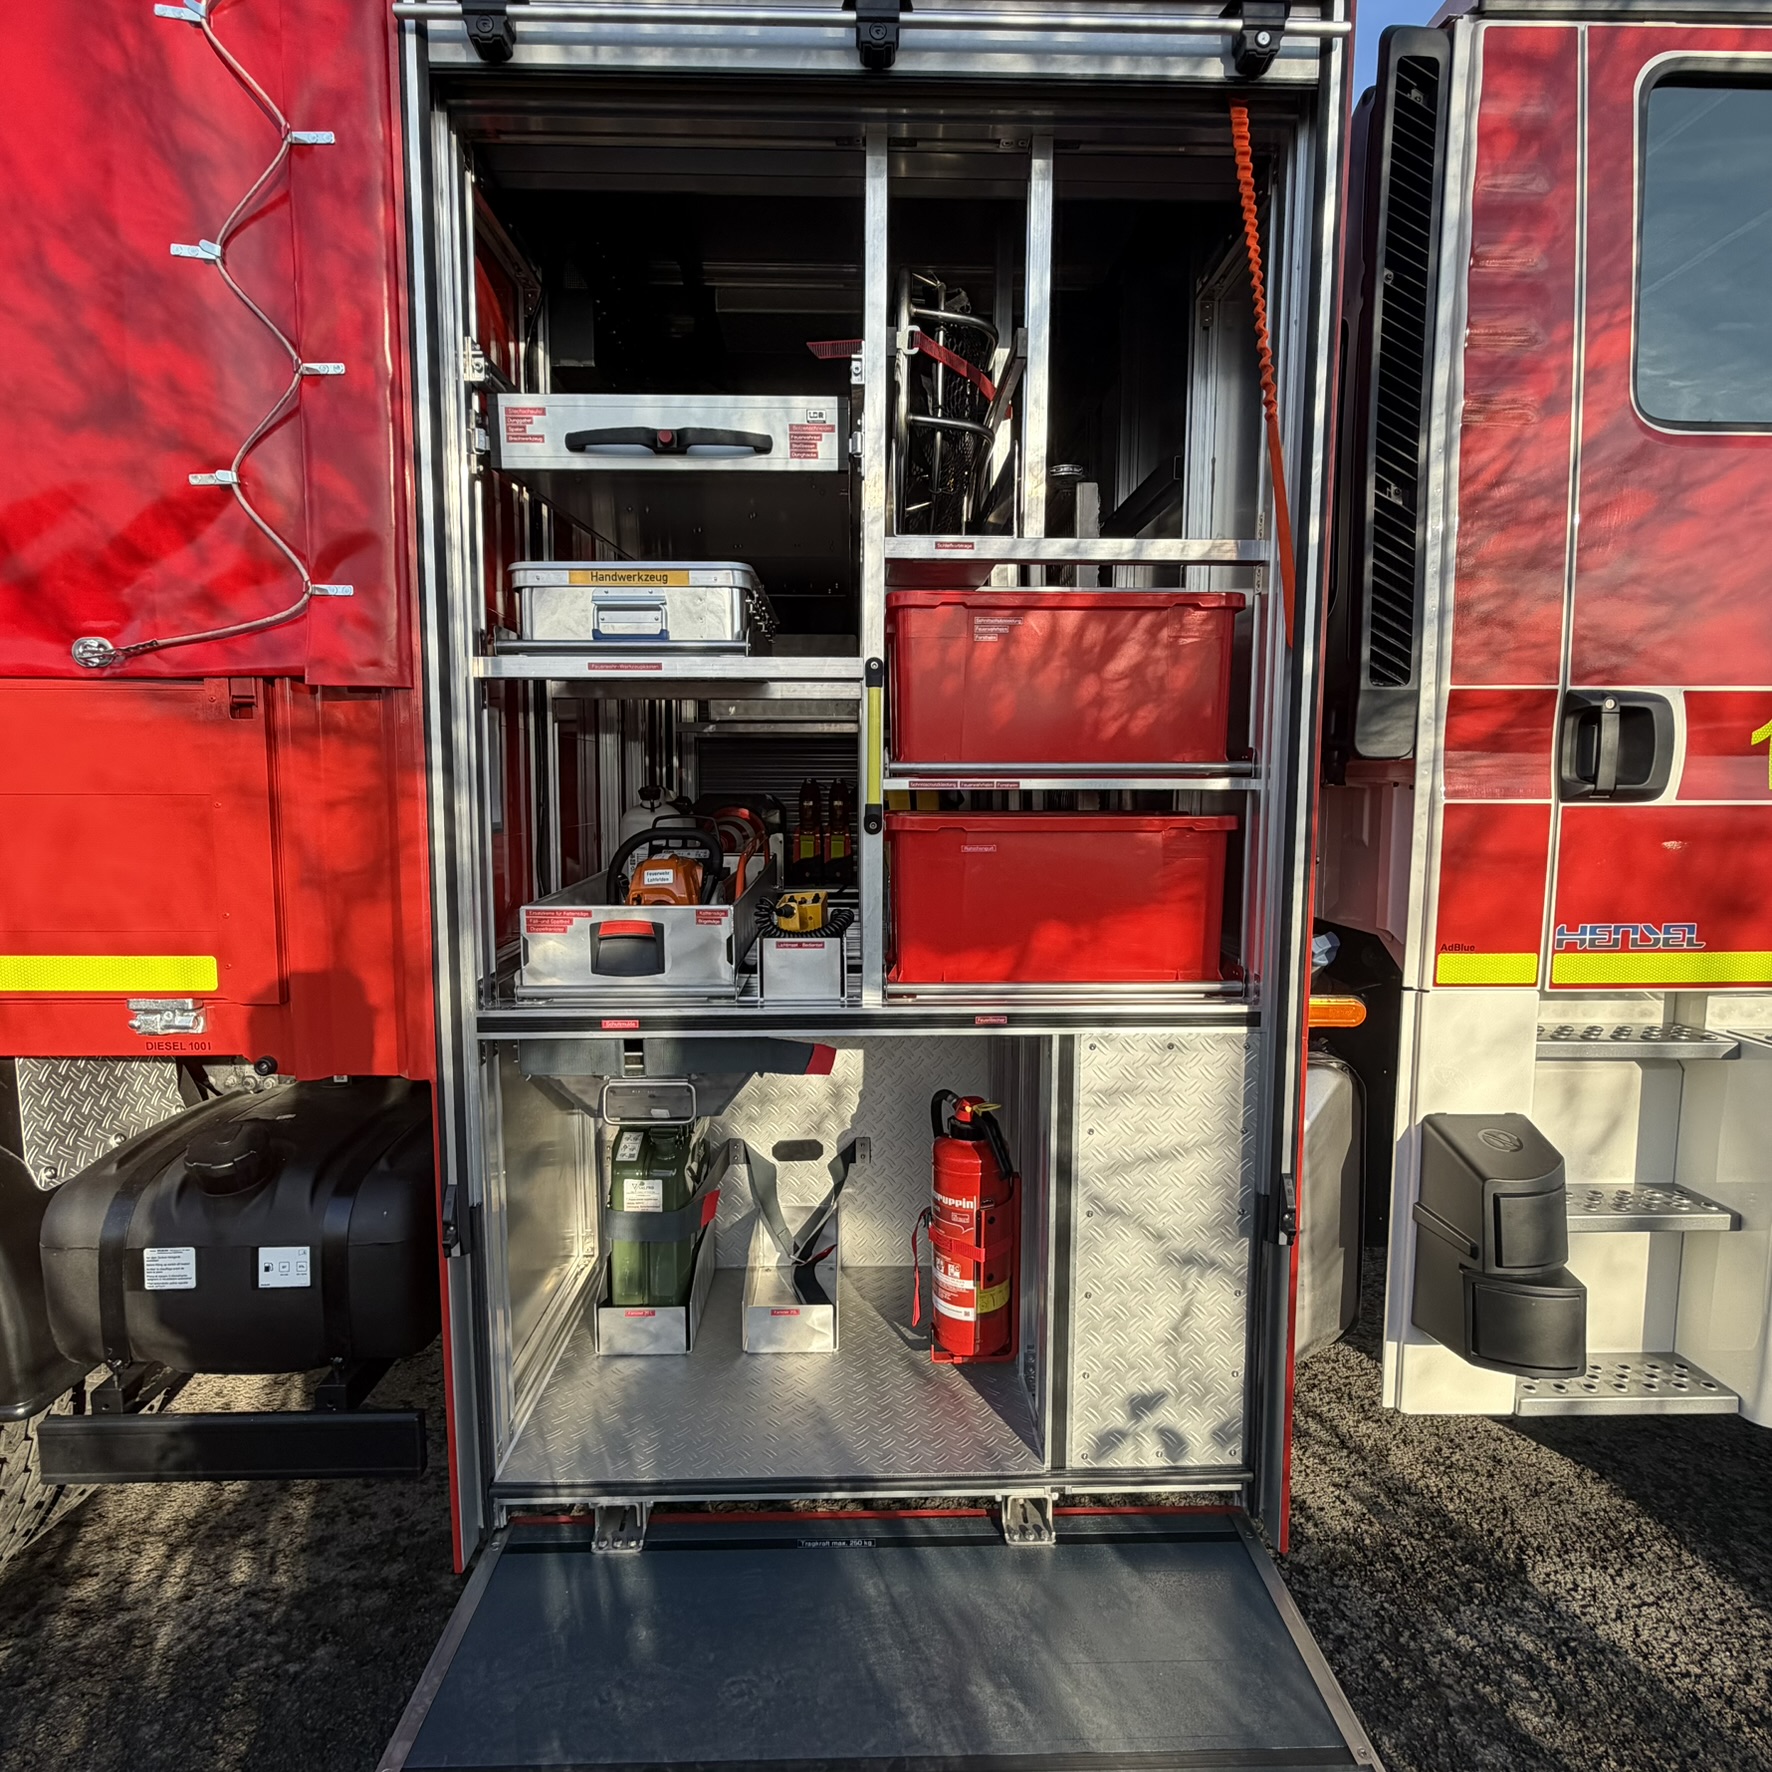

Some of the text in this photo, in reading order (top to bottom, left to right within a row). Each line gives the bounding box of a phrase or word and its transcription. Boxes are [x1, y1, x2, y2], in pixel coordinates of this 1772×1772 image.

[590, 571, 669, 584] Handwerkzeug
[1555, 923, 1706, 950] HENSEL
[146, 1042, 186, 1051] DIESEL
[933, 1191, 975, 1209] ruppin
